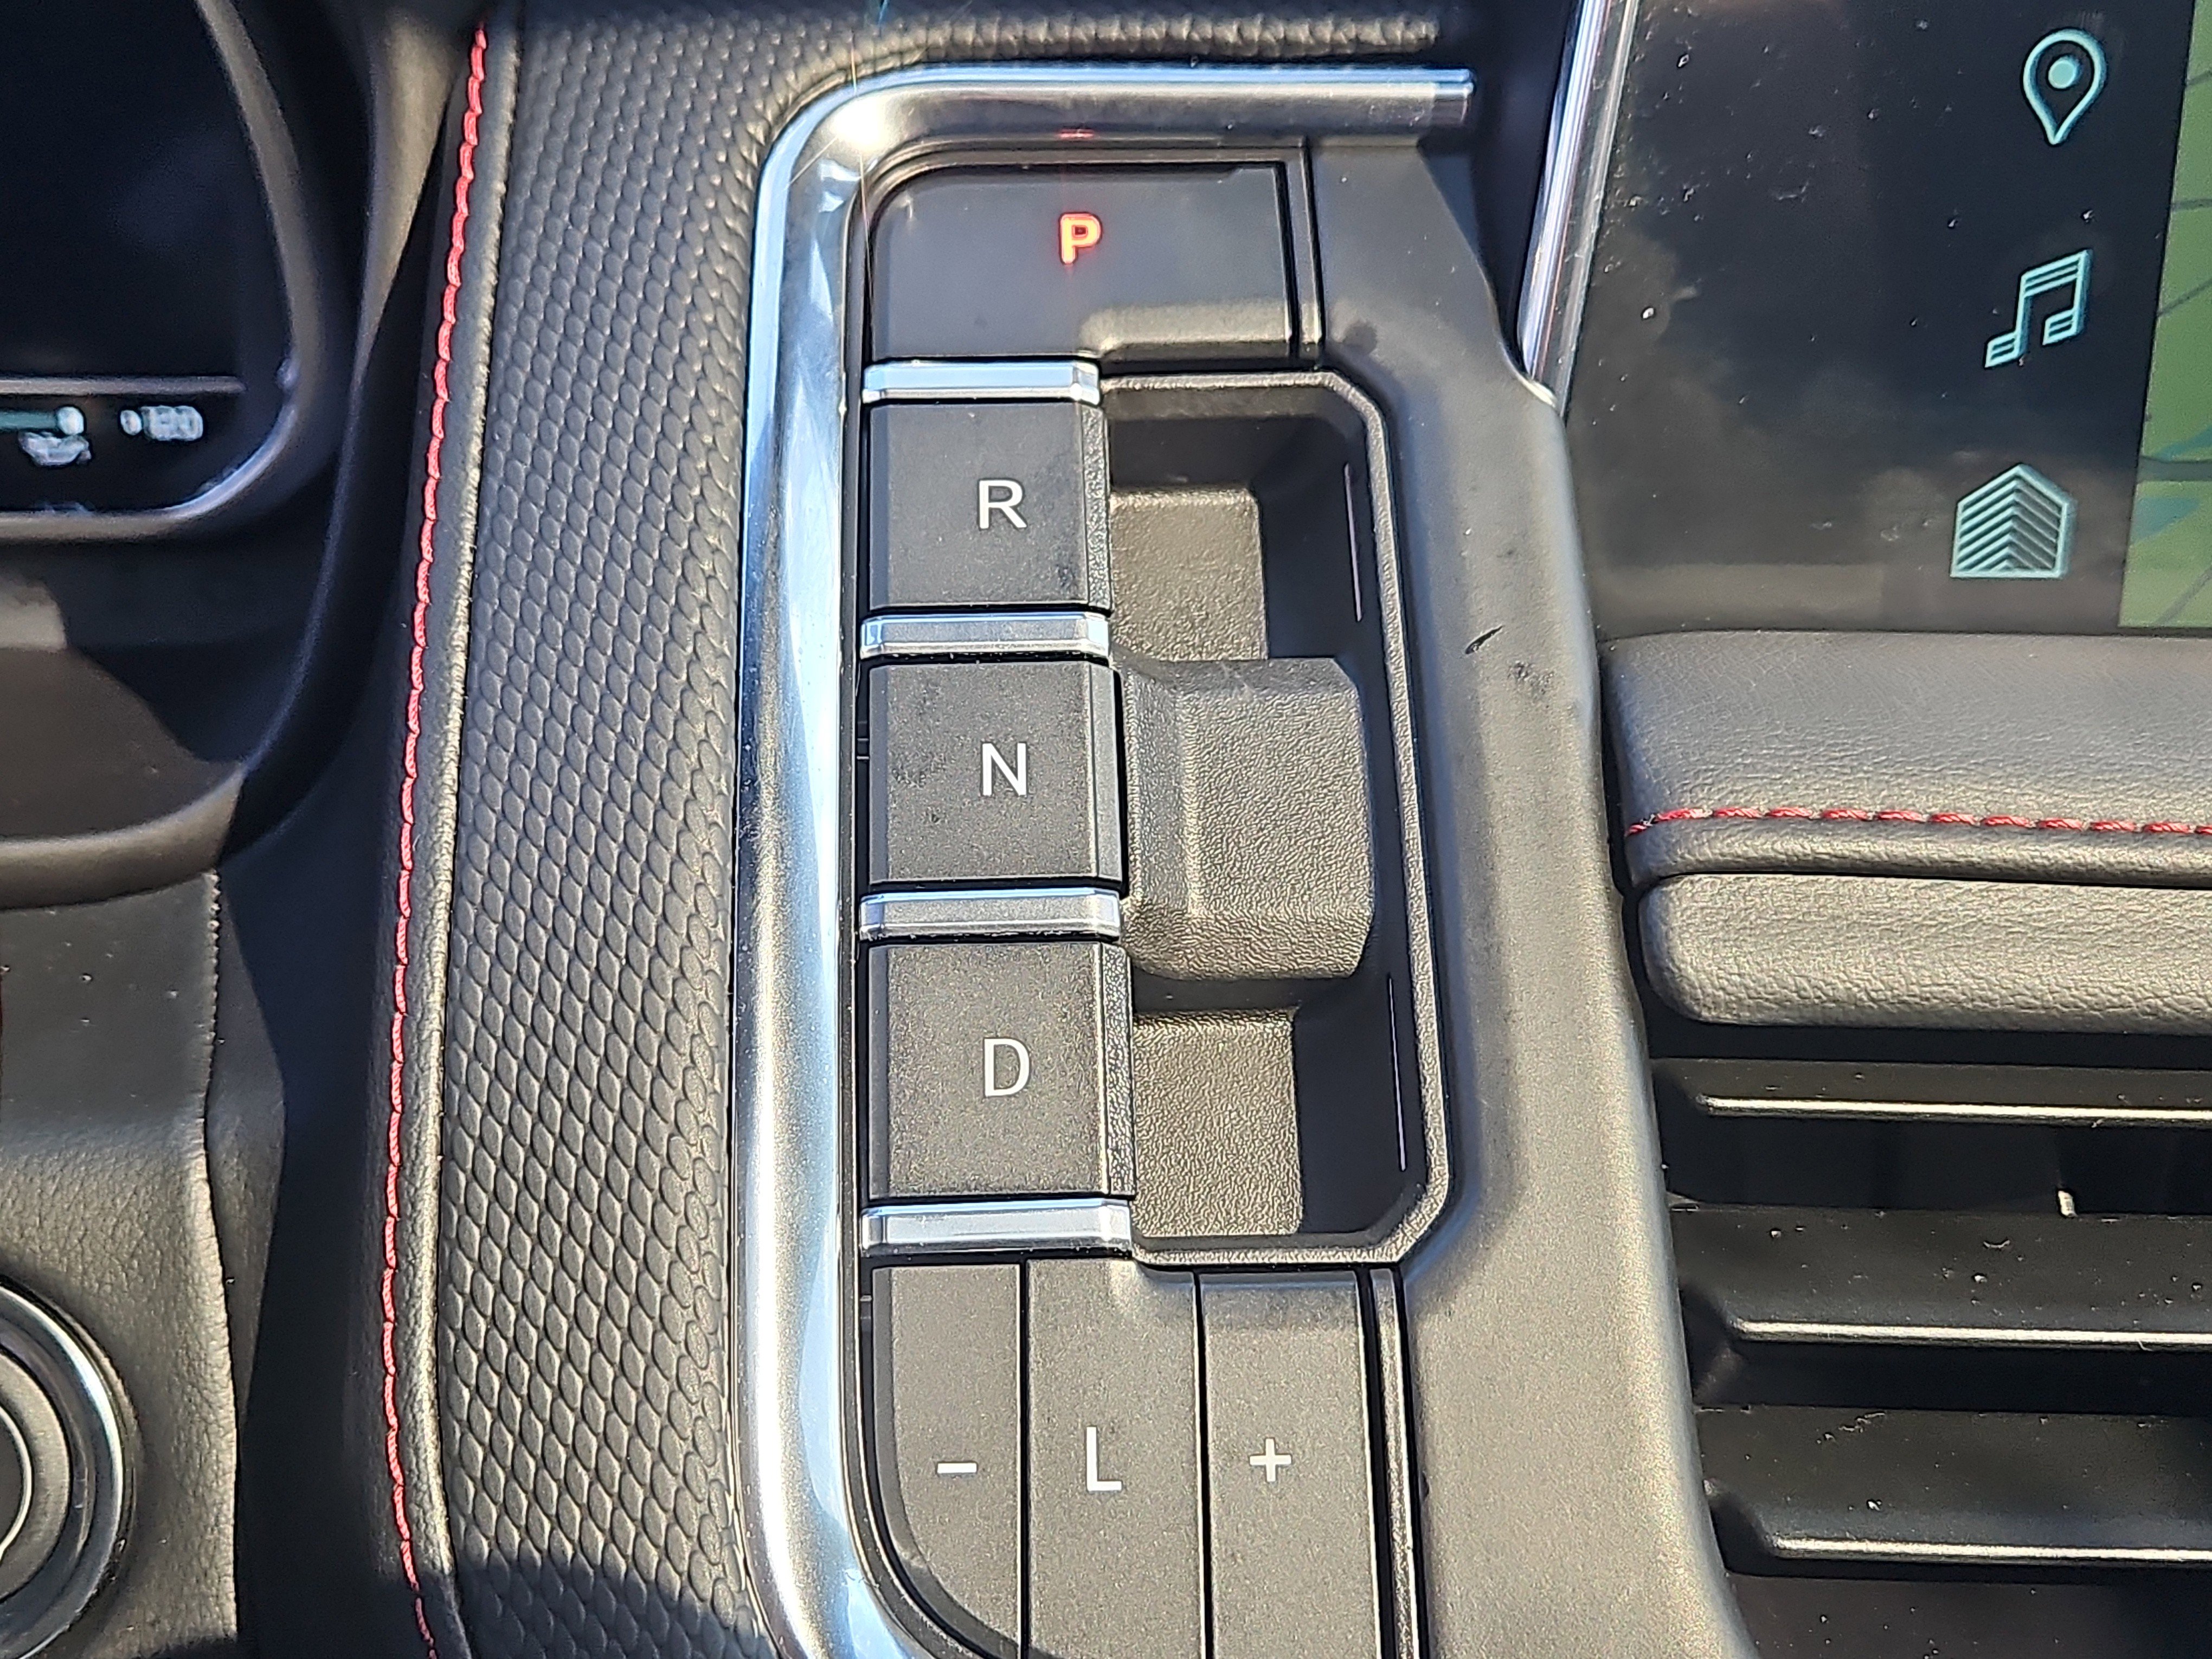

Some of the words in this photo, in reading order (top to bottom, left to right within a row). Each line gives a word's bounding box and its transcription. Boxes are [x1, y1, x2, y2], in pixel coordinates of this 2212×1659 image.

[1059, 213, 1102, 265] P
[978, 480, 1027, 529] R
[982, 743, 1027, 797] N
[983, 1038, 1030, 1097] D
[1086, 1426, 1122, 1492] L
